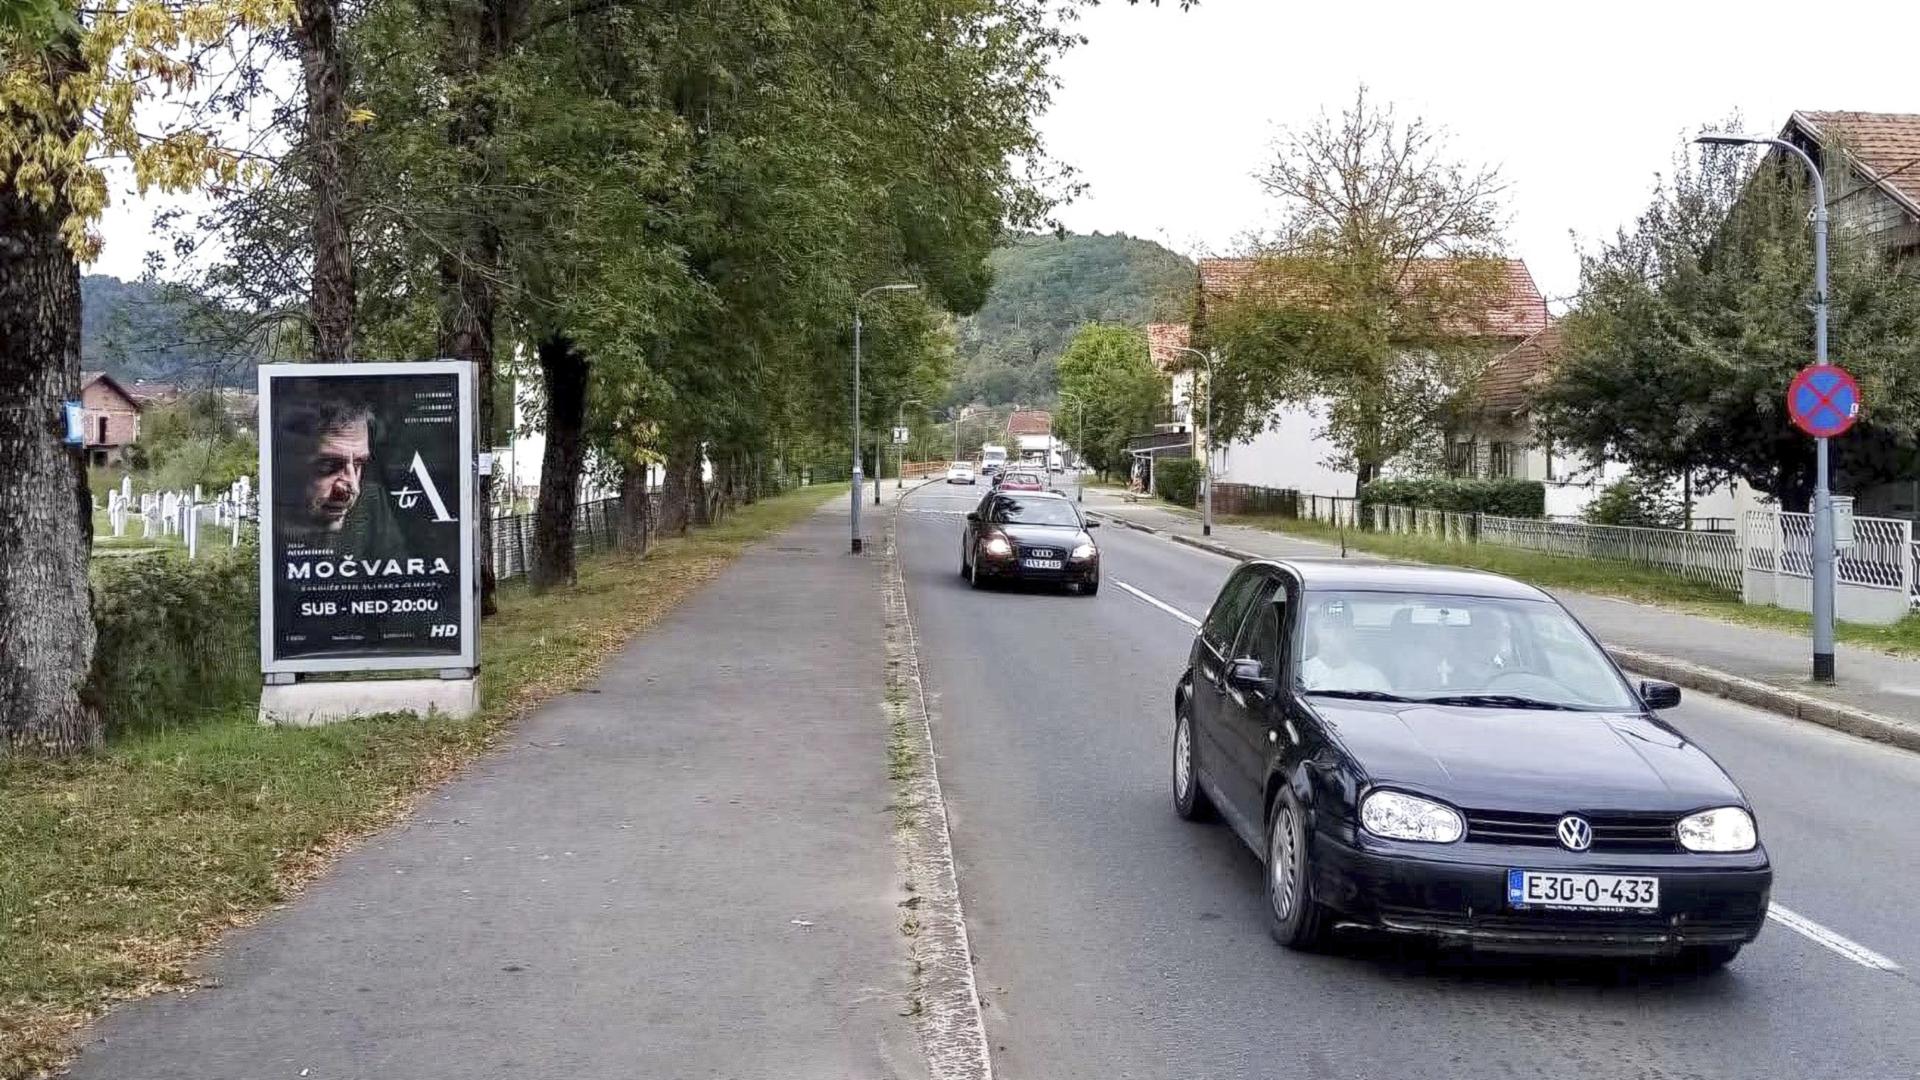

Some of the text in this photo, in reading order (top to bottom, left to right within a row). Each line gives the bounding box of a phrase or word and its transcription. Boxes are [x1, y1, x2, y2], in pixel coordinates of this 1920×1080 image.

[287, 554, 450, 580] MOČVARA
[301, 601, 337, 616] SUB
[351, 600, 388, 614] NED
[391, 598, 438, 613] 20:00
[430, 624, 458, 638] HD
